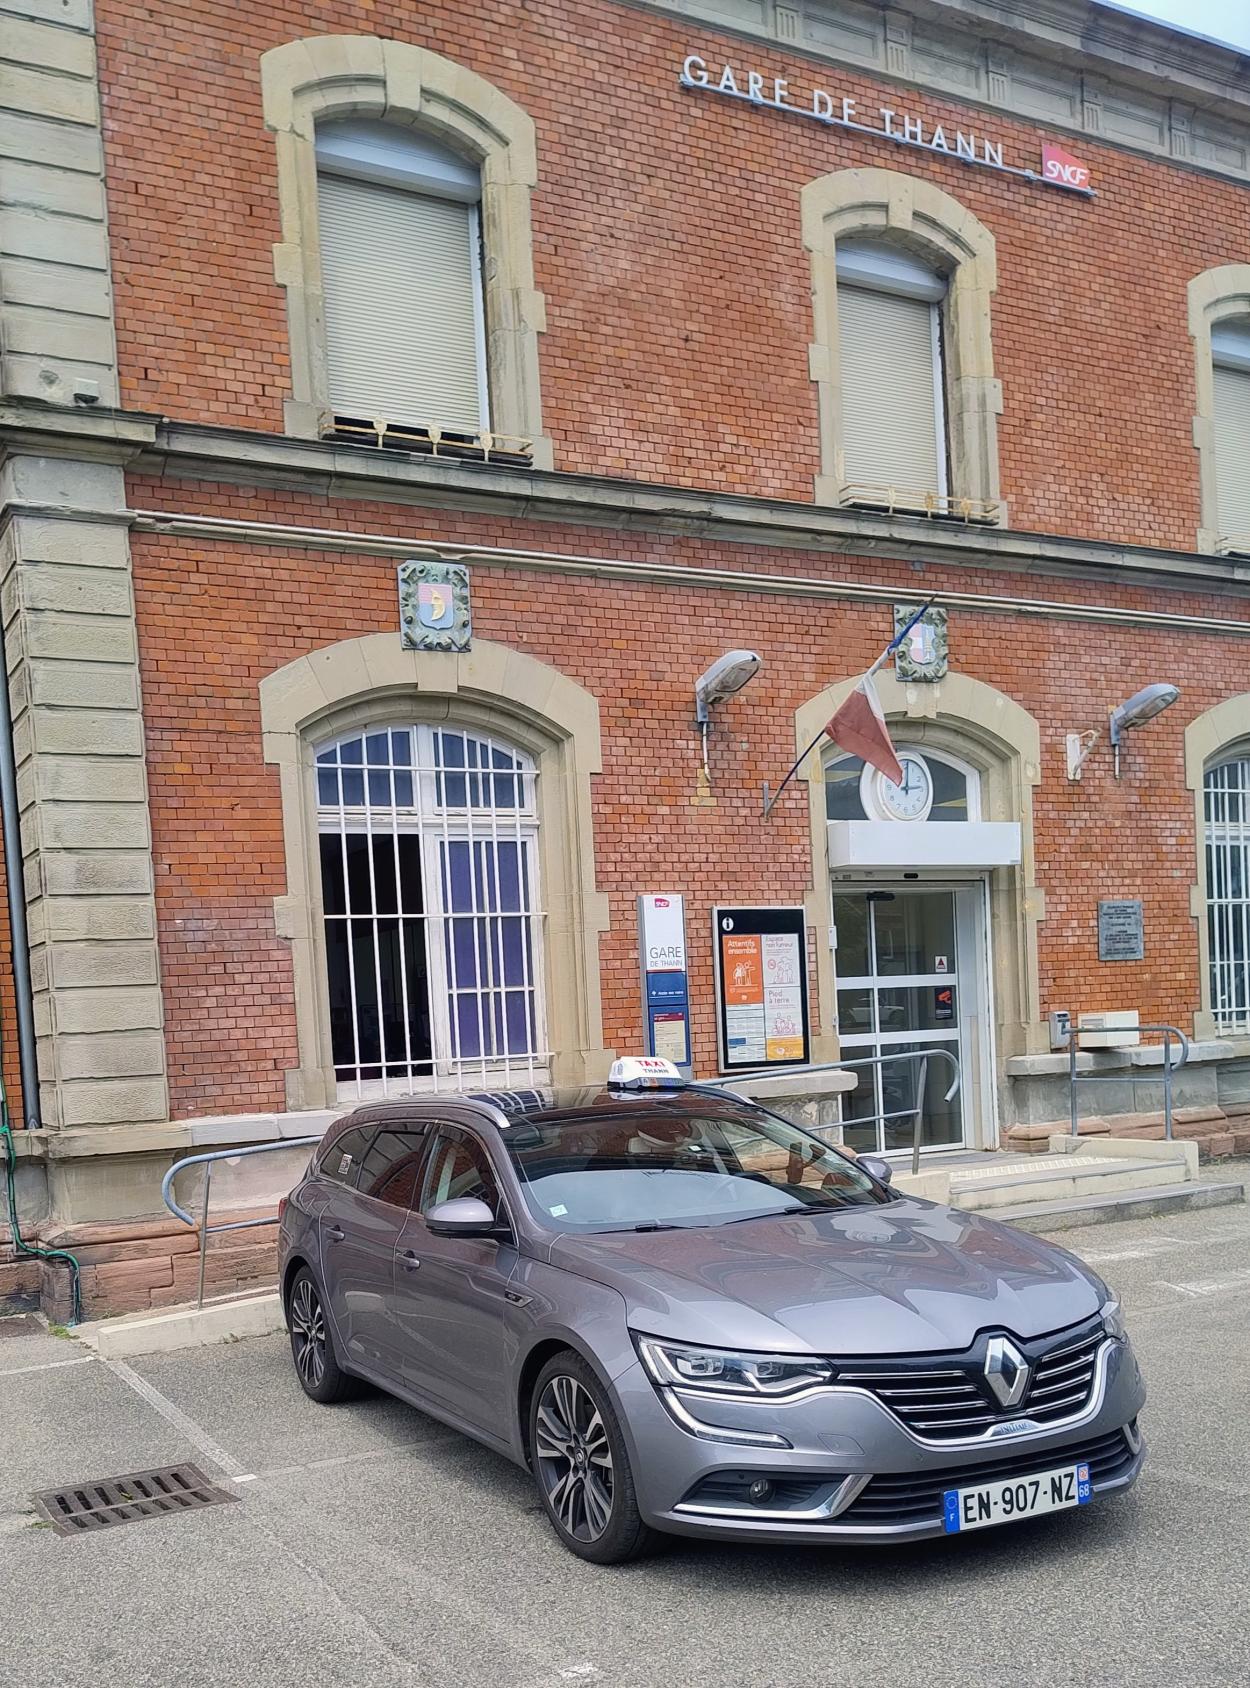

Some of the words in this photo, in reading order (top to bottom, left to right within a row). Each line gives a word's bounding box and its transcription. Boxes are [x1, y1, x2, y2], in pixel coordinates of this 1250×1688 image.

[683, 55, 789, 105] GARE
[813, 89, 857, 125] DE
[880, 108, 1003, 167] THANN
[1045, 160, 1089, 185] SNCF
[649, 946, 682, 959] GARE
[661, 959, 683, 967] THANN
[635, 1060, 666, 1068] TAXI
[949, 1512, 955, 1523] F
[963, 1471, 1076, 1524] EN-907-NZ
[1079, 1483, 1090, 1498] 68
